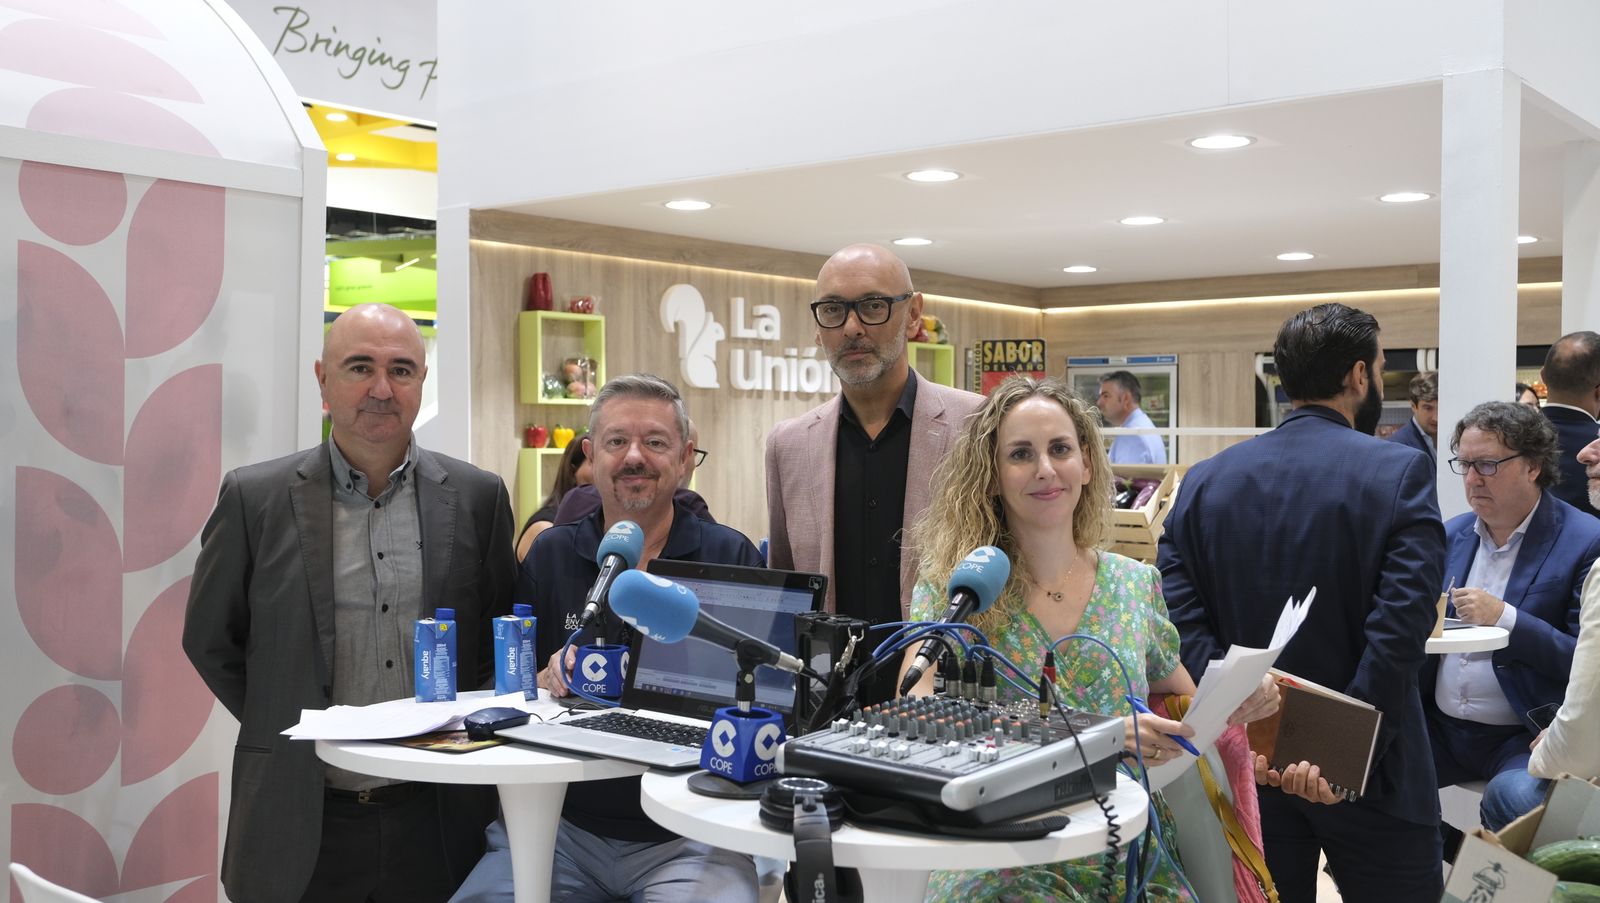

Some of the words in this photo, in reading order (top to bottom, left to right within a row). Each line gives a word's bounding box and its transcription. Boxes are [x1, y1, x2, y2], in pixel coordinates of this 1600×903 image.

[273, 6, 410, 90] Bringing
[730, 297, 781, 341] La
[984, 341, 1043, 363] SABOR
[421, 650, 430, 679] aqualy
[507, 646, 517, 675] aqualy
[582, 683, 607, 693] COPE
[709, 757, 733, 774] COPE
